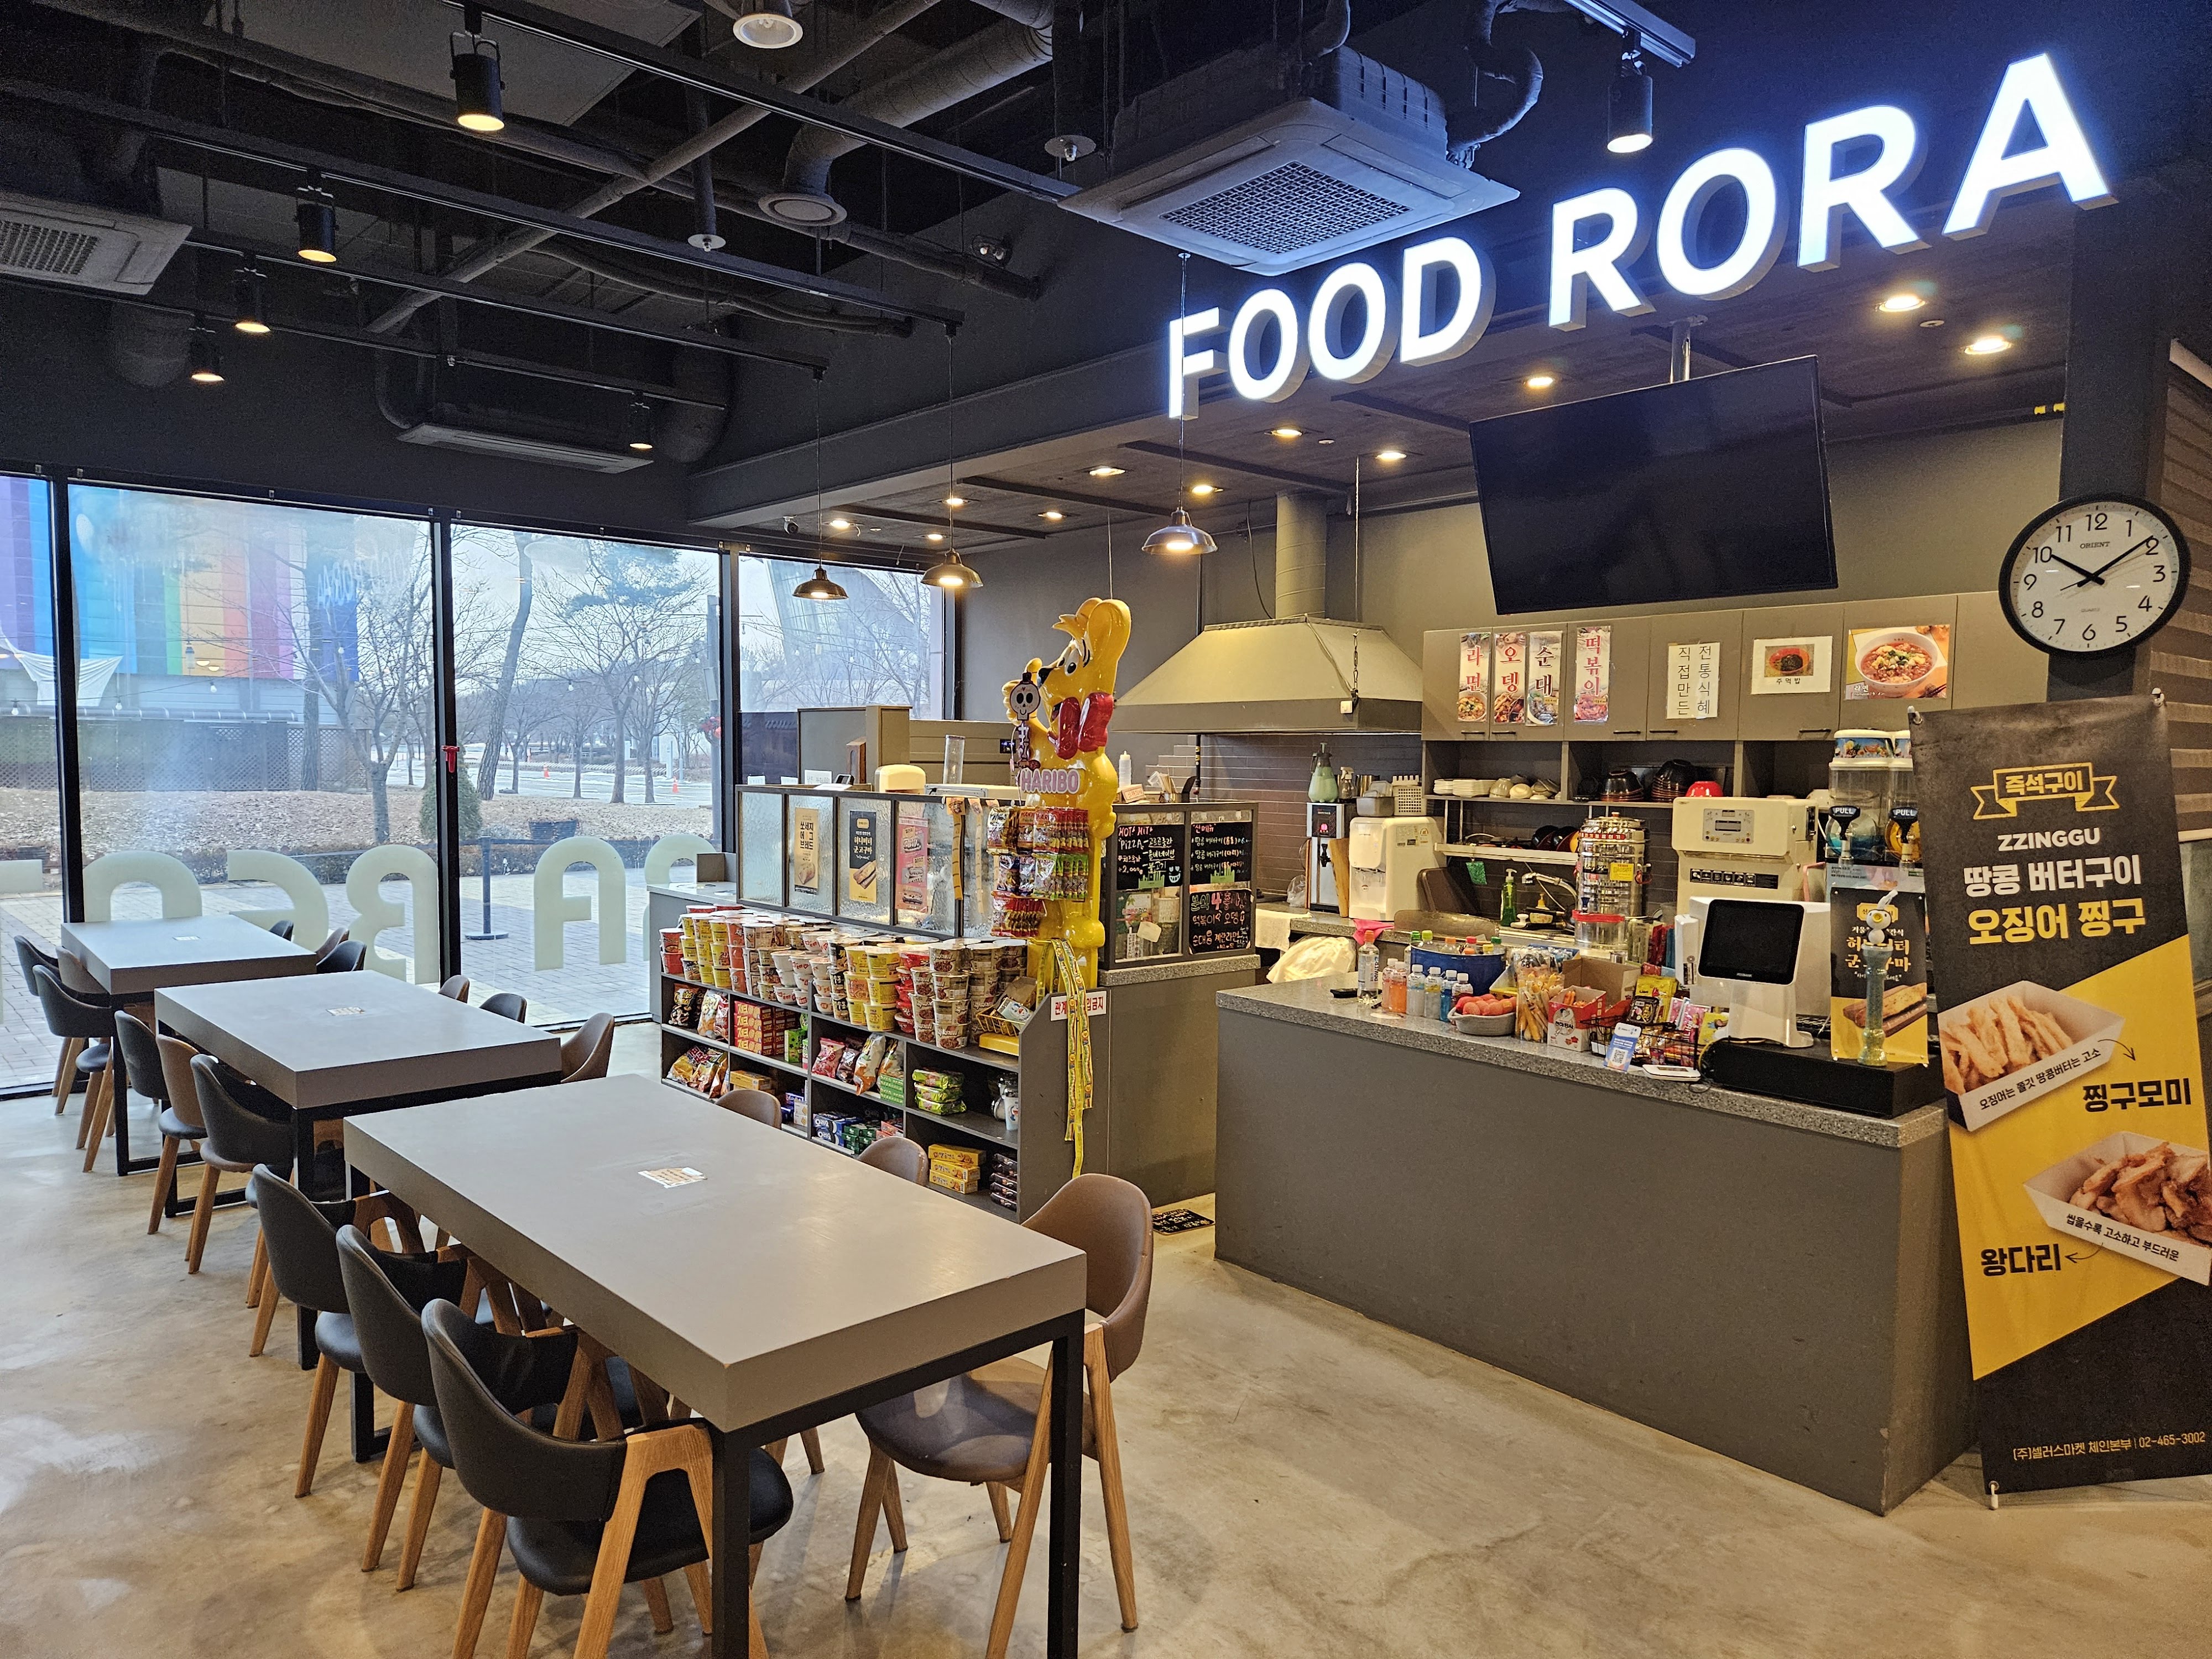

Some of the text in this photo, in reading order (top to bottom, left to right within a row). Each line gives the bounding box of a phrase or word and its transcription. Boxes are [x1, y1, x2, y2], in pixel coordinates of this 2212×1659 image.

[1170, 53, 2111, 419] FOOD RORA
[2085, 513, 2107, 531] 12
[2126, 519, 2132, 537] 1
[2056, 525, 2072, 542] 11
[2033, 546, 2052, 563] 10
[2146, 538, 2159, 555] 2
[2023, 573, 2037, 591] 9
[2153, 565, 2166, 582] 3
[2032, 601, 2043, 618] 8
[2138, 596, 2152, 612] 4
[2053, 619, 2065, 634] 7
[2082, 624, 2096, 640] 6
[2115, 615, 2127, 632] 5
[1466, 645, 1484, 693] 라면
[1500, 646, 1521, 693] 오뎅
[1535, 645, 1556, 697] 순대
[1584, 635, 1602, 697] 떡볶이
[1697, 645, 1712, 714] 전통식혜
[1021, 768, 1080, 794] HARIBO
[2005, 770, 2083, 794] 즉석구이
[1997, 827, 2100, 851] ZZINGGU
[1964, 854, 2141, 898] 땅콩 버터구이
[1968, 898, 2147, 945] 오징어 찡구
[1846, 936, 1909, 955] 허터
[1845, 954, 1911, 972] 군마
[1087, 997, 1103, 1011] 입금지
[1979, 1047, 2101, 1110] 오징어는 쫄깃 땅콩버터는 고소
[2083, 1078, 2192, 1113] 찡구모미
[2066, 1213, 2179, 1262] 씹을수록 고소하고 부드러운
[1980, 1243, 2062, 1276] 왕다리
[2088, 1438, 2131, 1453] 체인본부
[2138, 1431, 2205, 1449] 02-465-3002
